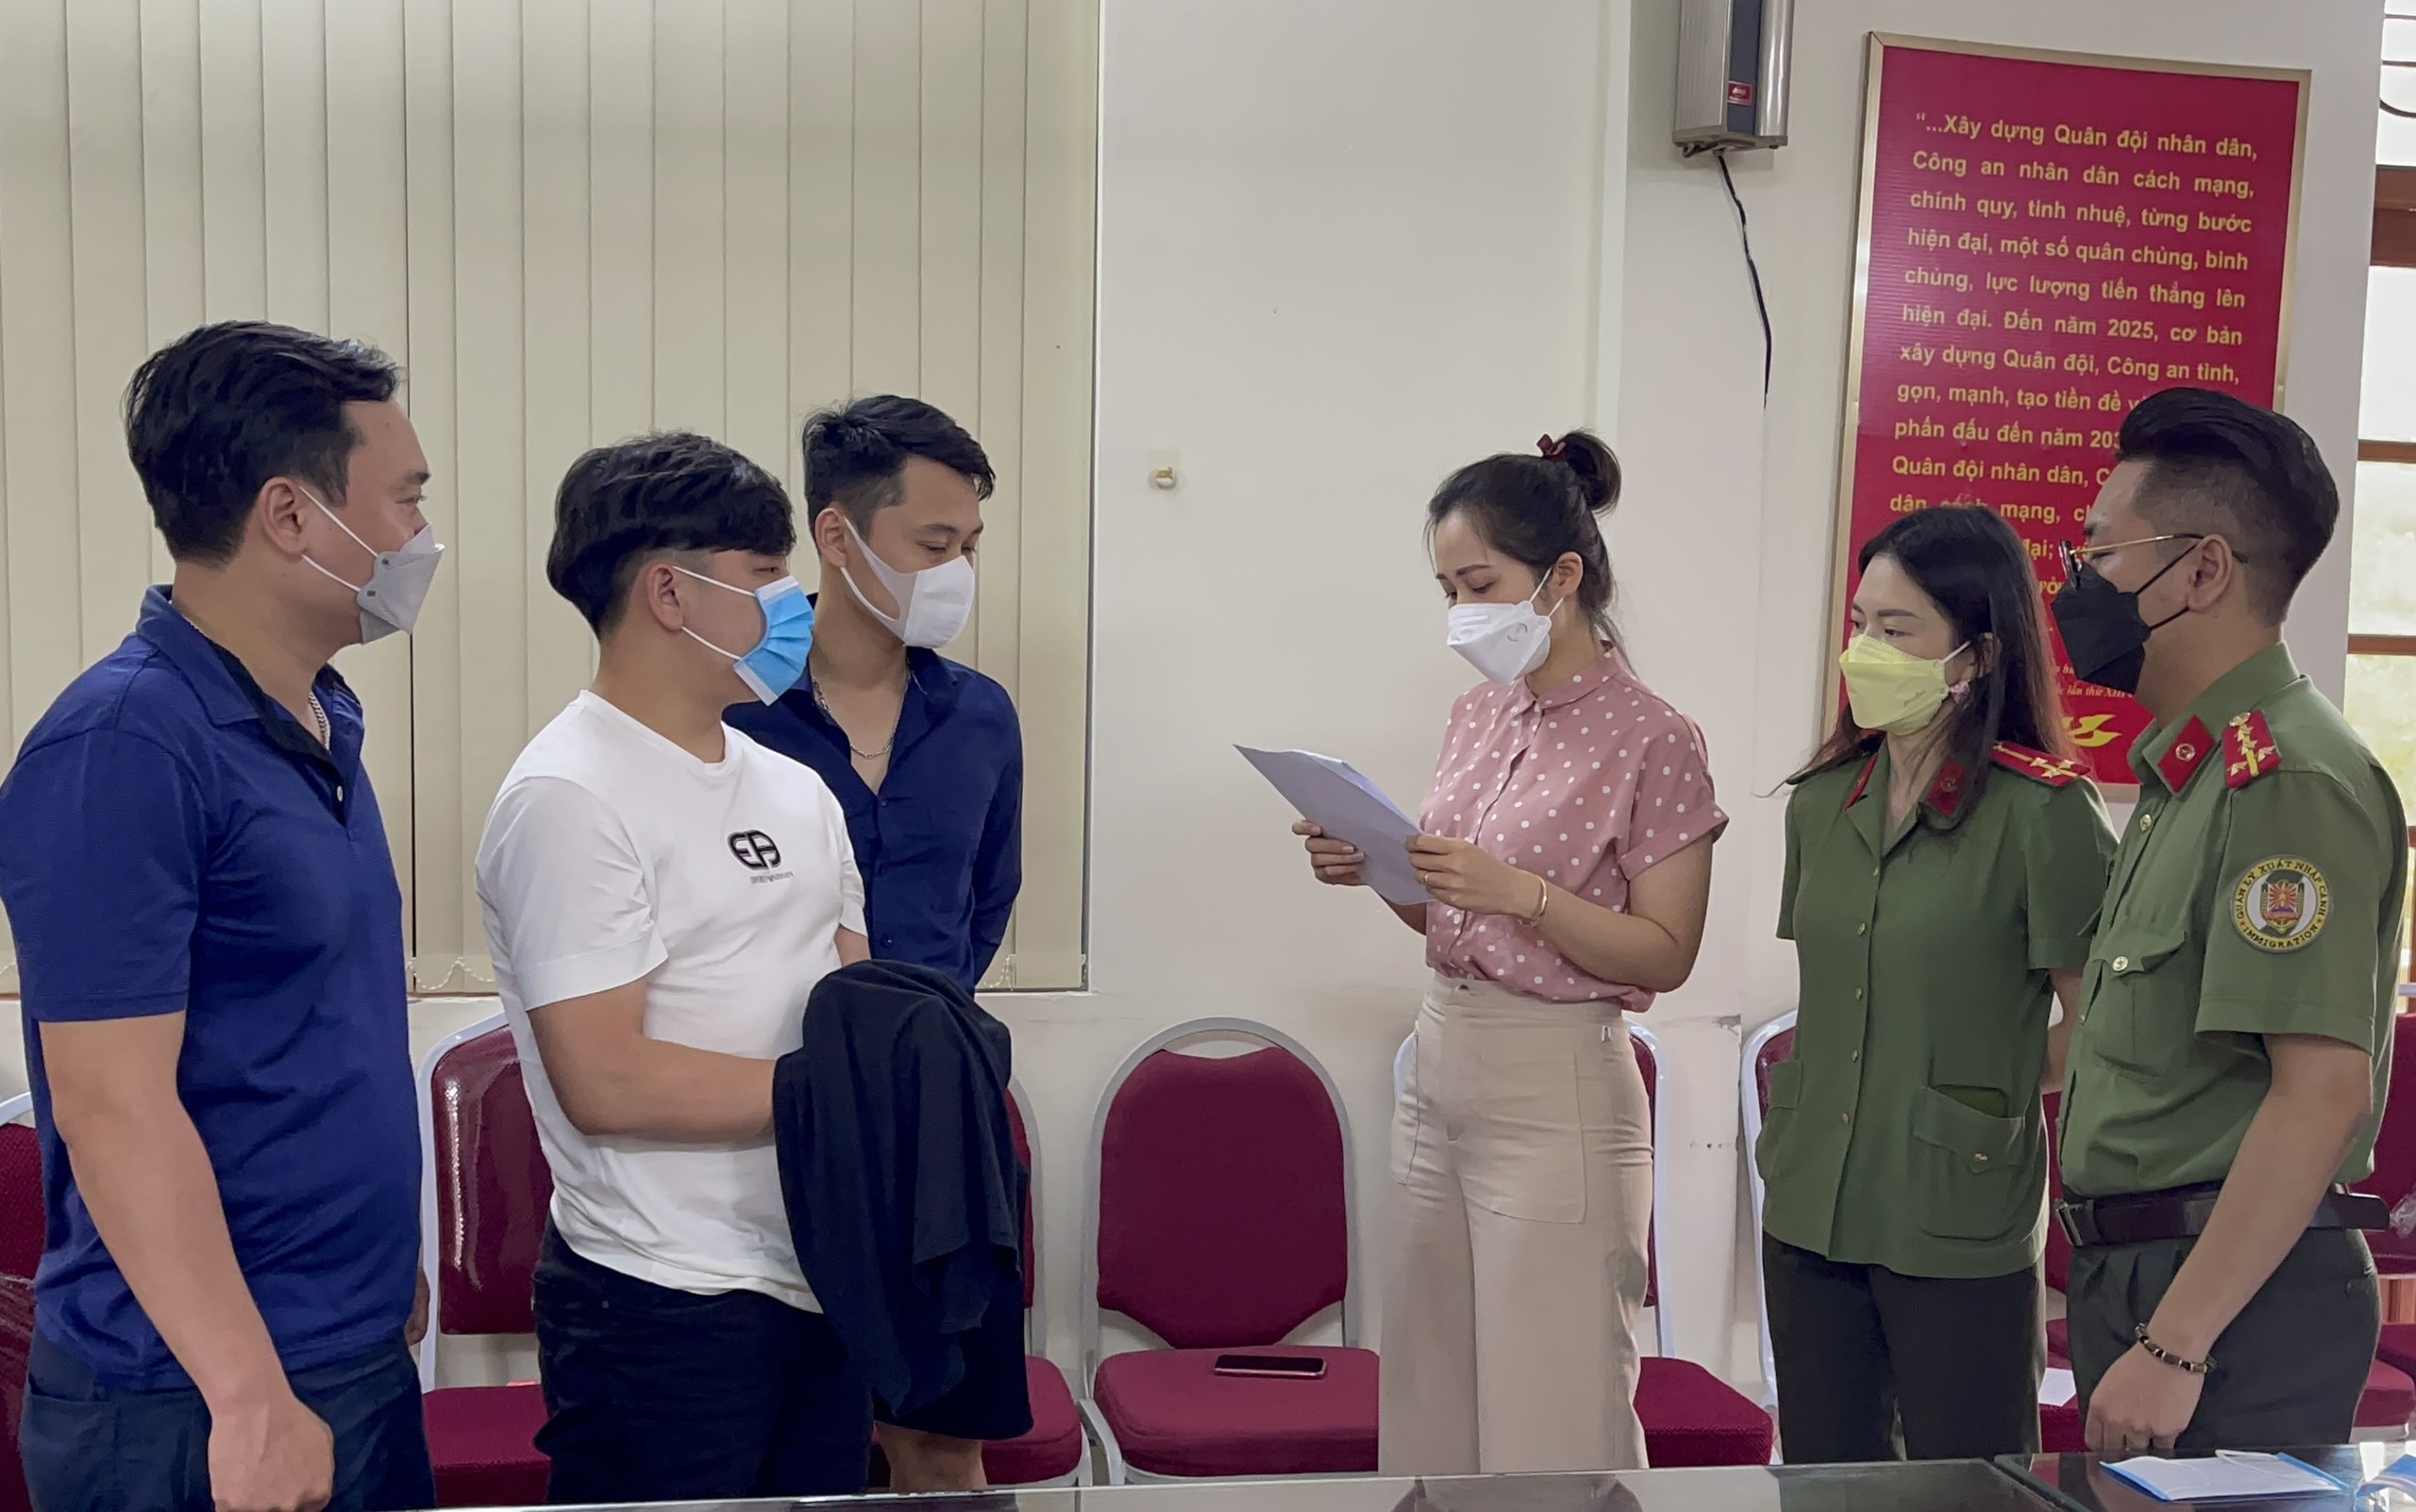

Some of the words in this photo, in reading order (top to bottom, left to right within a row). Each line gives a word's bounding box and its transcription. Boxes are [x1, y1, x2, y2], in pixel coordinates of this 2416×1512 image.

[1991, 120, 2044, 145] dựng
[2055, 125, 2106, 145] Quân
[2117, 130, 2147, 153] đội
[2158, 134, 2206, 153] nhân
[2216, 138, 2257, 160] dân,
[1913, 151, 1966, 177] Công
[1981, 161, 2005, 176] an
[2020, 161, 2068, 181] nhân
[2083, 166, 2119, 185] dân
[2134, 170, 2179, 190] cách
[2194, 178, 2253, 199] mạng,
[1910, 191, 1966, 210] chính
[1977, 199, 2017, 219] quy,
[2077, 204, 2130, 227] nhuệ,
[2141, 208, 2188, 232] từng
[2199, 212, 2251, 232] bước
[1908, 227, 1950, 251] hiện
[1958, 232, 1992, 255] đại,
[2001, 237, 2038, 259] một
[2045, 236, 2069, 257] số
[2076, 243, 2124, 263] quân
[2206, 250, 2247, 270] binh
[1987, 272, 2018, 294] lực
[2030, 276, 2089, 301] lượng
[2102, 277, 2138, 300] tiến
[2217, 289, 2244, 307] lên
[1903, 304, 1944, 327] hiện
[1957, 309, 1991, 330] đại.
[2004, 309, 2042, 330] Đến
[2055, 316, 2096, 334] năm
[2107, 319, 2157, 342] 2025,
[2171, 326, 2196, 341] cơ
[2207, 326, 2241, 344] bản
[1900, 343, 1935, 366] xây
[1942, 344, 1995, 370] dựng
[2004, 349, 2055, 369] Quân
[2064, 354, 2099, 376] đội,
[2107, 357, 2158, 380] Công
[2167, 365, 2189, 378] an
[1898, 385, 1940, 403] gọn,
[1949, 386, 2009, 407] mạnh,
[2017, 389, 2048, 410] tạo
[2055, 387, 2090, 409] tiền
[2098, 390, 2121, 412] đề
[1895, 416, 1944, 440] phấn
[1953, 418, 1988, 442] đấu
[1997, 421, 2033, 443] đến
[2041, 428, 2082, 446] năm
[1893, 456, 1945, 476] Quân
[1953, 460, 1984, 481] đội
[1991, 462, 2039, 480] nhân
[2047, 465, 2088, 487] dân,
[2001, 504, 2059, 524] mạng,
[2242, 923, 2319, 949] IMMIGRATION
